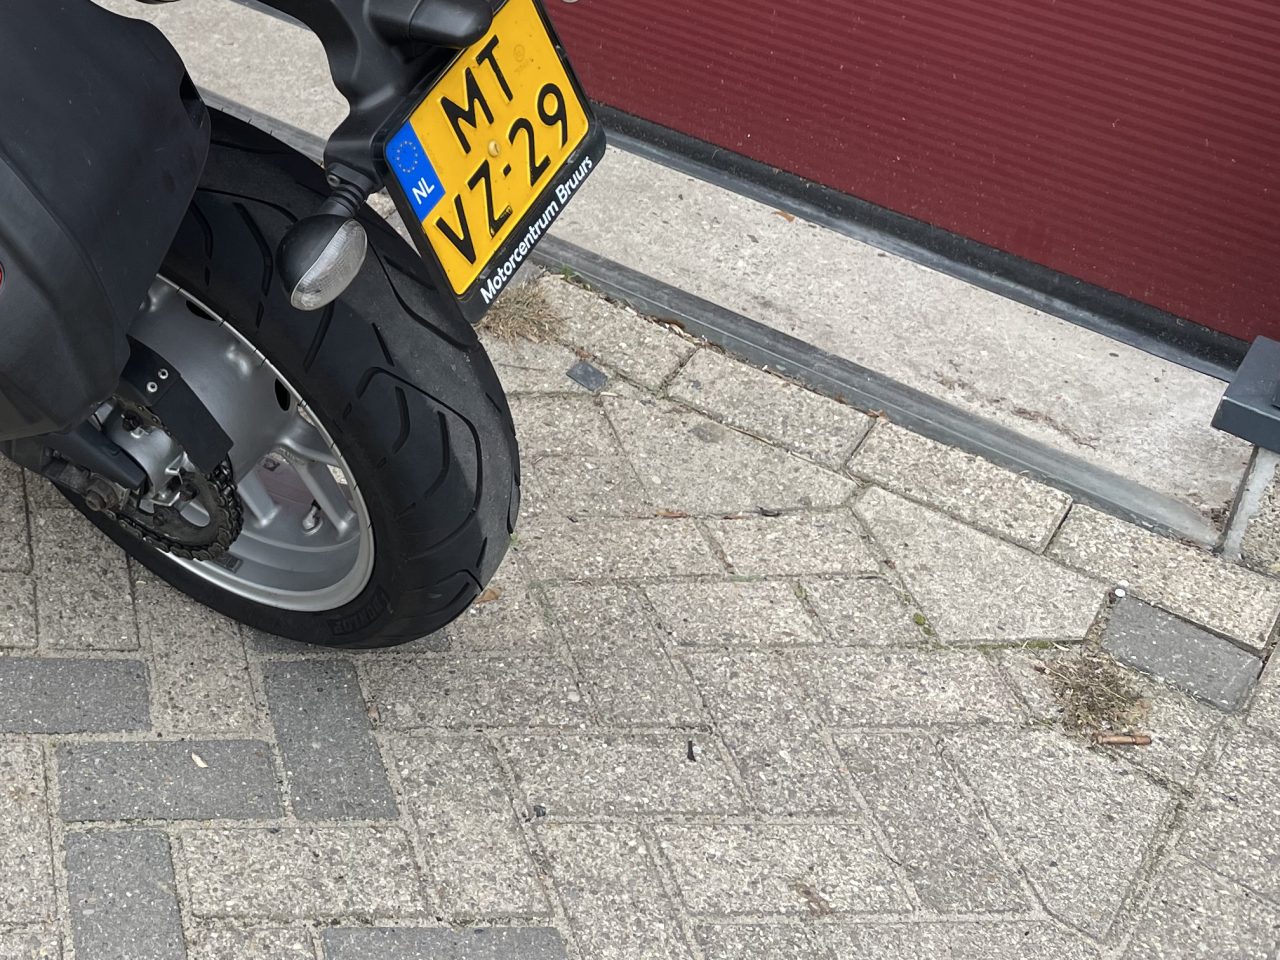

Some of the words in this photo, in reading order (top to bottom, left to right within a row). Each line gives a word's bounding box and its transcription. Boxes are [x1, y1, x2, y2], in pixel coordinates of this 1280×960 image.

[439, 34, 514, 155] MT
[411, 177, 436, 205] NL
[434, 83, 568, 265] VZ-29
[479, 200, 560, 304] Motorcentrum
[554, 155, 593, 204] Bruurs
